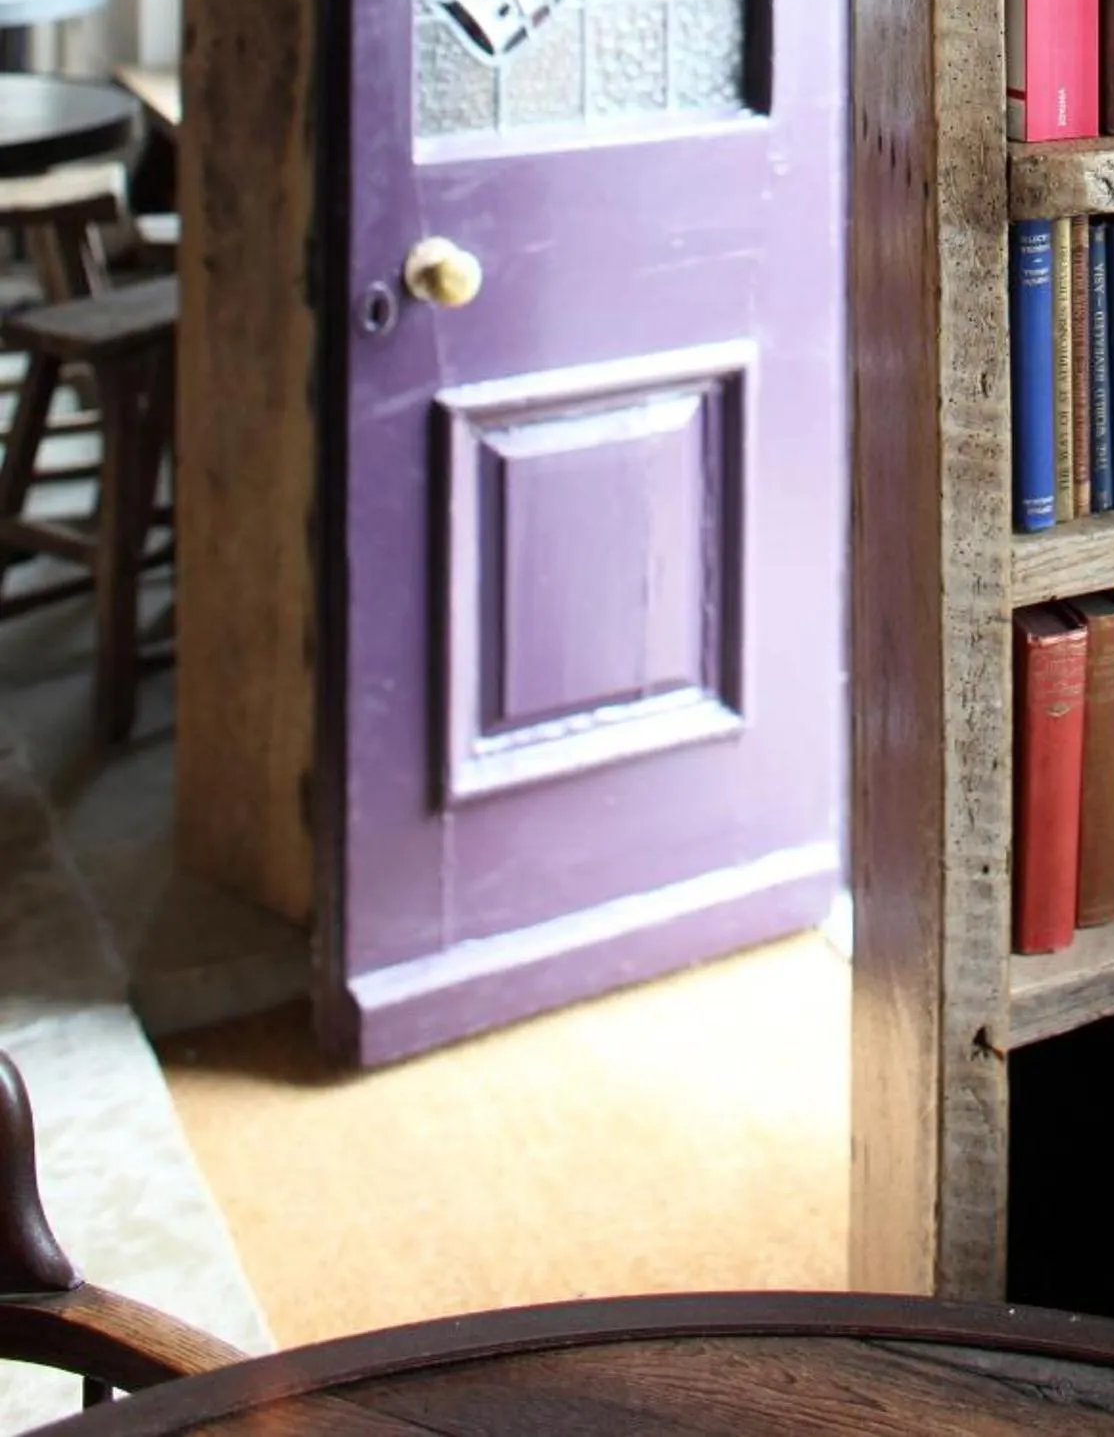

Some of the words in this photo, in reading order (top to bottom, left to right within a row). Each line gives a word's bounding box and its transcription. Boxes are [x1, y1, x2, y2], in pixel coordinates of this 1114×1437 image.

[1094, 262, 1104, 294] ASIA
[1095, 311, 1106, 382] REVEALED
[1058, 410, 1068, 426] OF
[1096, 388, 1107, 435] WORLD
[1058, 430, 1068, 461] WAY
[1097, 444, 1107, 469] THE
[1059, 469, 1068, 490] THE
